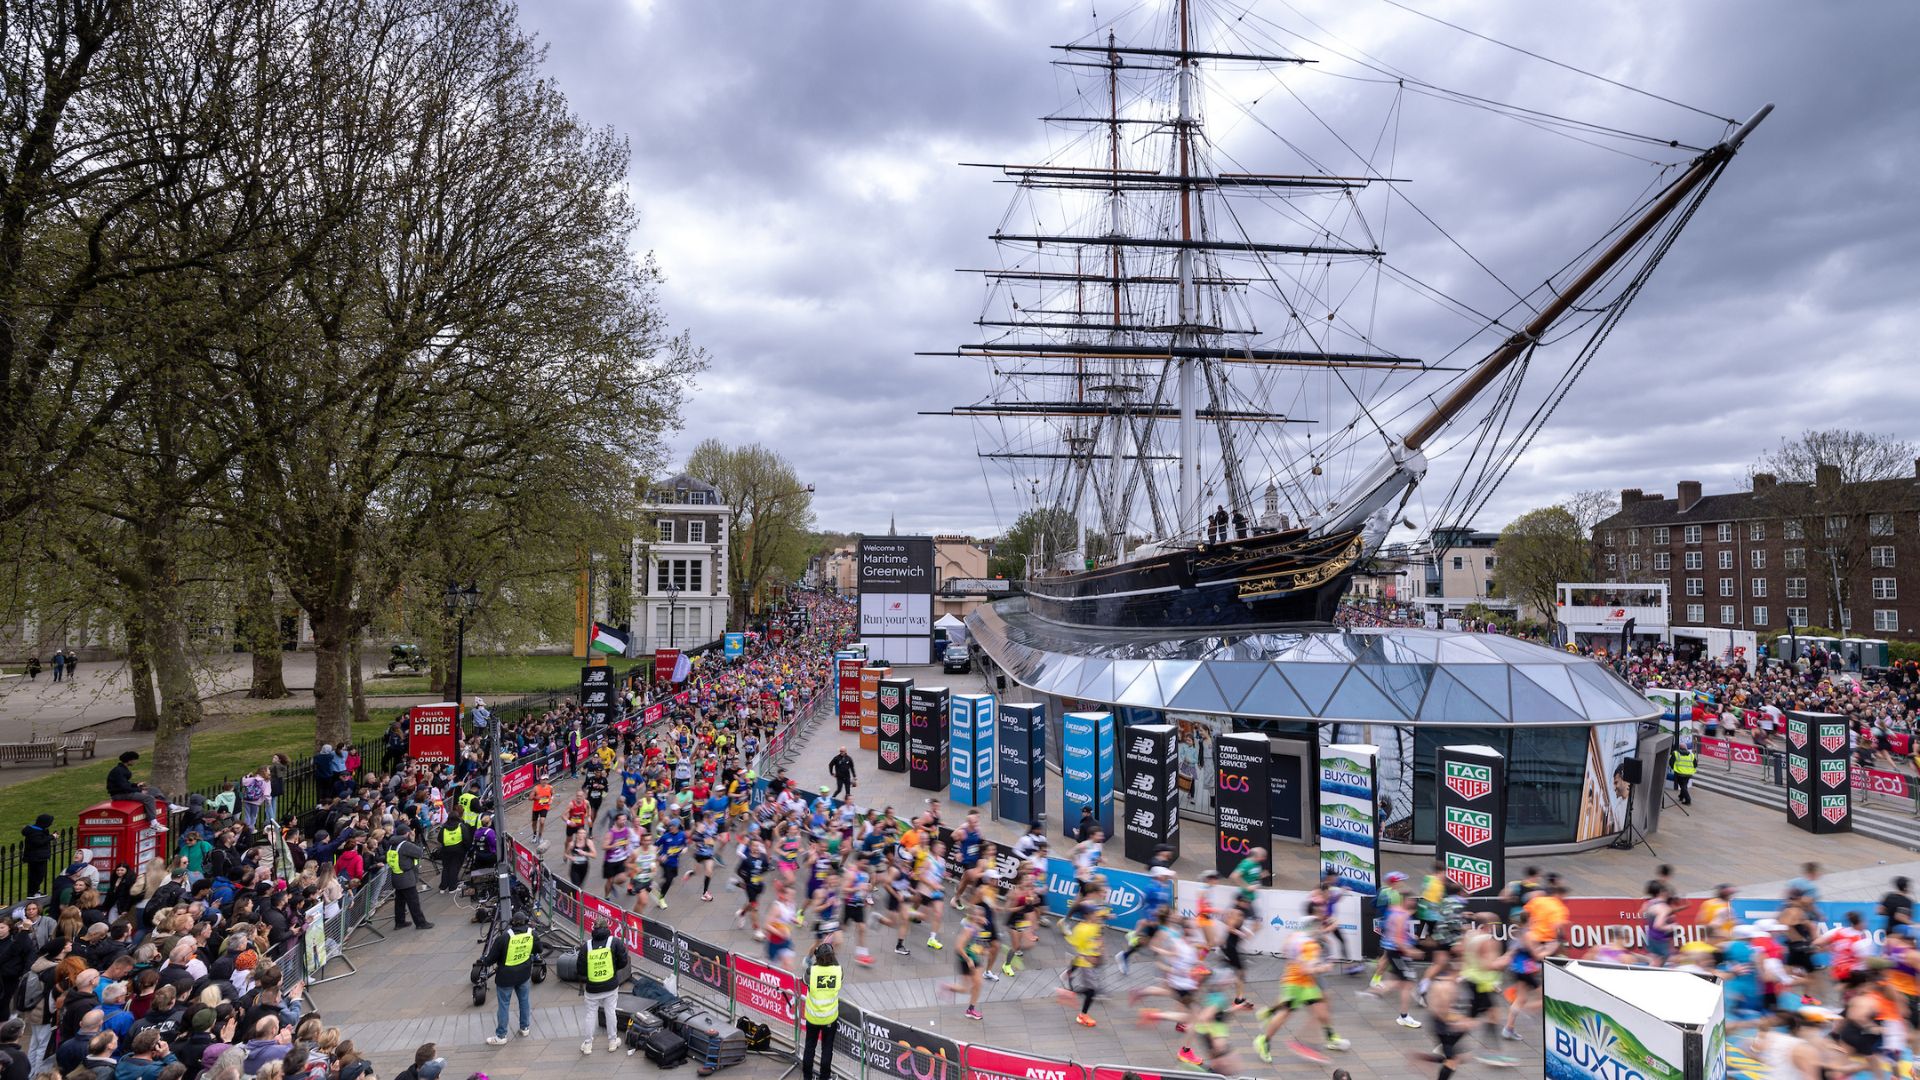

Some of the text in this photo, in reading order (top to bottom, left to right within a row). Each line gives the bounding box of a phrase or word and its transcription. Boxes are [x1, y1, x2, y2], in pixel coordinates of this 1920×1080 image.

[863, 554, 908, 563] Maritime
[863, 565, 924, 576] Greenwich
[863, 614, 928, 627] Run your way.
[587, 671, 606, 682] NB
[587, 692, 606, 702] NB
[882, 688, 897, 696] TAG
[912, 712, 928, 728] tcs
[1000, 713, 1018, 725] Lingo
[1747, 713, 1757, 726] tc
[414, 723, 450, 735] PRIDE
[1066, 721, 1088, 732] Lucozade
[1791, 722, 1806, 733] TAG
[1823, 727, 1842, 736] TAG
[953, 729, 970, 740] Abbott
[1790, 732, 1807, 748] HEUER
[1066, 744, 1088, 756] Lucozade
[1131, 736, 1154, 755] NB
[1219, 745, 1238, 753] TATA
[1821, 736, 1845, 751] HEUER
[1000, 744, 1018, 758] Lingo
[912, 755, 928, 772] tcs
[1127, 752, 1138, 760] new
[1138, 754, 1158, 765] balance
[1220, 752, 1263, 764] CONSULTANCY
[1220, 760, 1248, 768] SERVICES
[1792, 756, 1806, 768] TAG
[1066, 766, 1088, 778] Lucozade
[1450, 765, 1487, 779] TAG
[1824, 762, 1843, 770] TAG
[1000, 774, 1018, 787] Lingo
[1220, 768, 1250, 793] tcs
[1324, 769, 1368, 787] BUXTON
[1790, 766, 1808, 783] HEUER
[1822, 772, 1846, 787] HEUER
[952, 778, 970, 790] Abbott
[1131, 772, 1154, 791] NB
[1448, 777, 1489, 798] HEUER
[1066, 790, 1088, 801] Lucozade
[1127, 788, 1138, 796] new
[1138, 790, 1158, 801] balance
[1792, 791, 1806, 802] TAG
[1791, 800, 1808, 817] HEUER
[1824, 798, 1844, 806] TAG
[1131, 808, 1154, 827] NB
[1220, 807, 1239, 815] TATA
[1823, 808, 1846, 823] HEUER
[1220, 814, 1264, 825] CONSULTANCY
[1450, 810, 1488, 826] TAG
[1127, 824, 1138, 832] new
[1138, 826, 1158, 837] balance
[1220, 822, 1248, 830] SERVICES
[1324, 815, 1369, 835] BUXTON
[1448, 823, 1489, 844] HEUER
[1221, 830, 1250, 855] tcs
[1450, 856, 1488, 873] TAG
[1325, 862, 1371, 883] BUXTON
[1448, 869, 1489, 891] HEUER
[1672, 924, 1708, 947] RID
